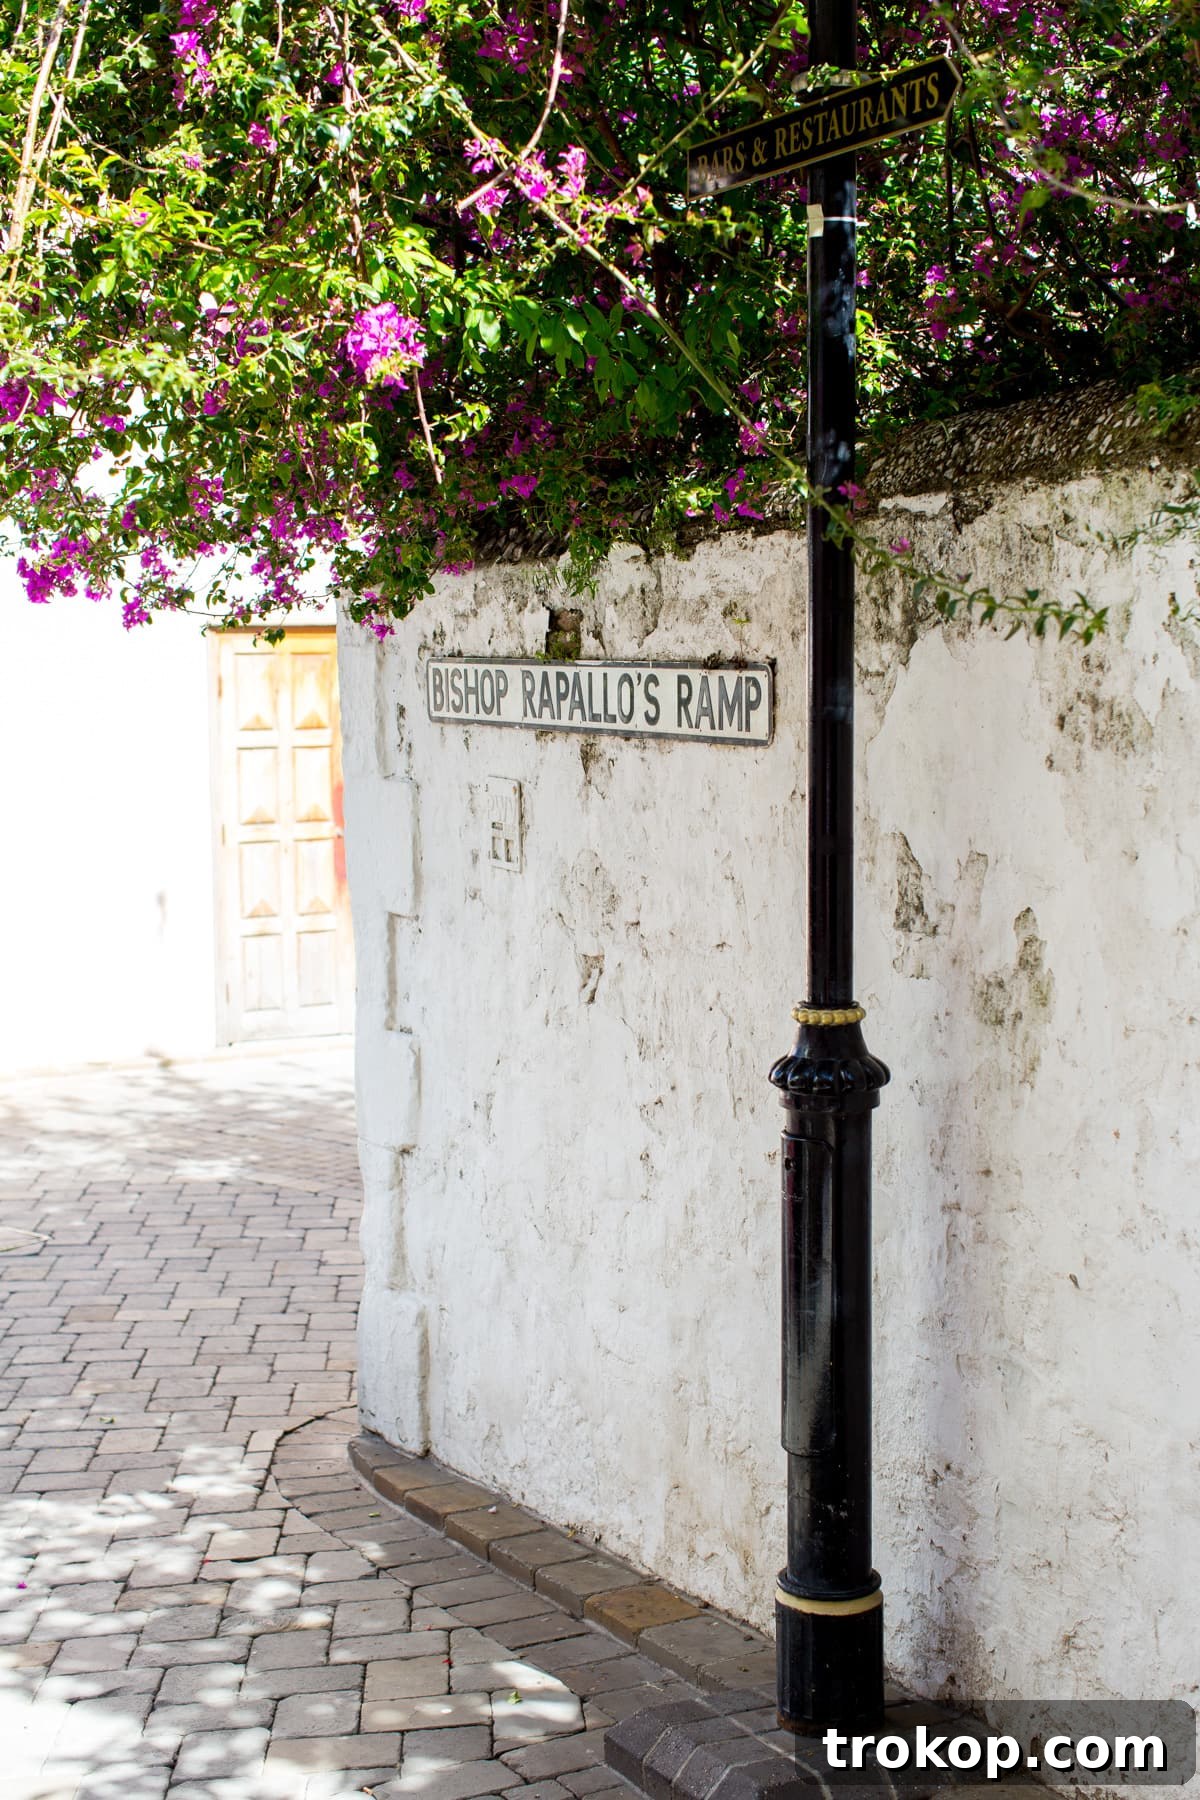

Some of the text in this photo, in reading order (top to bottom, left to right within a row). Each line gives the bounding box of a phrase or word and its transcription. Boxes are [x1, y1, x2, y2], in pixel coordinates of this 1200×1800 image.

[697, 71, 940, 184] BARS & RESTAURANTS
[432, 667, 763, 732] BISHOP RAPALLO'S RAMP
